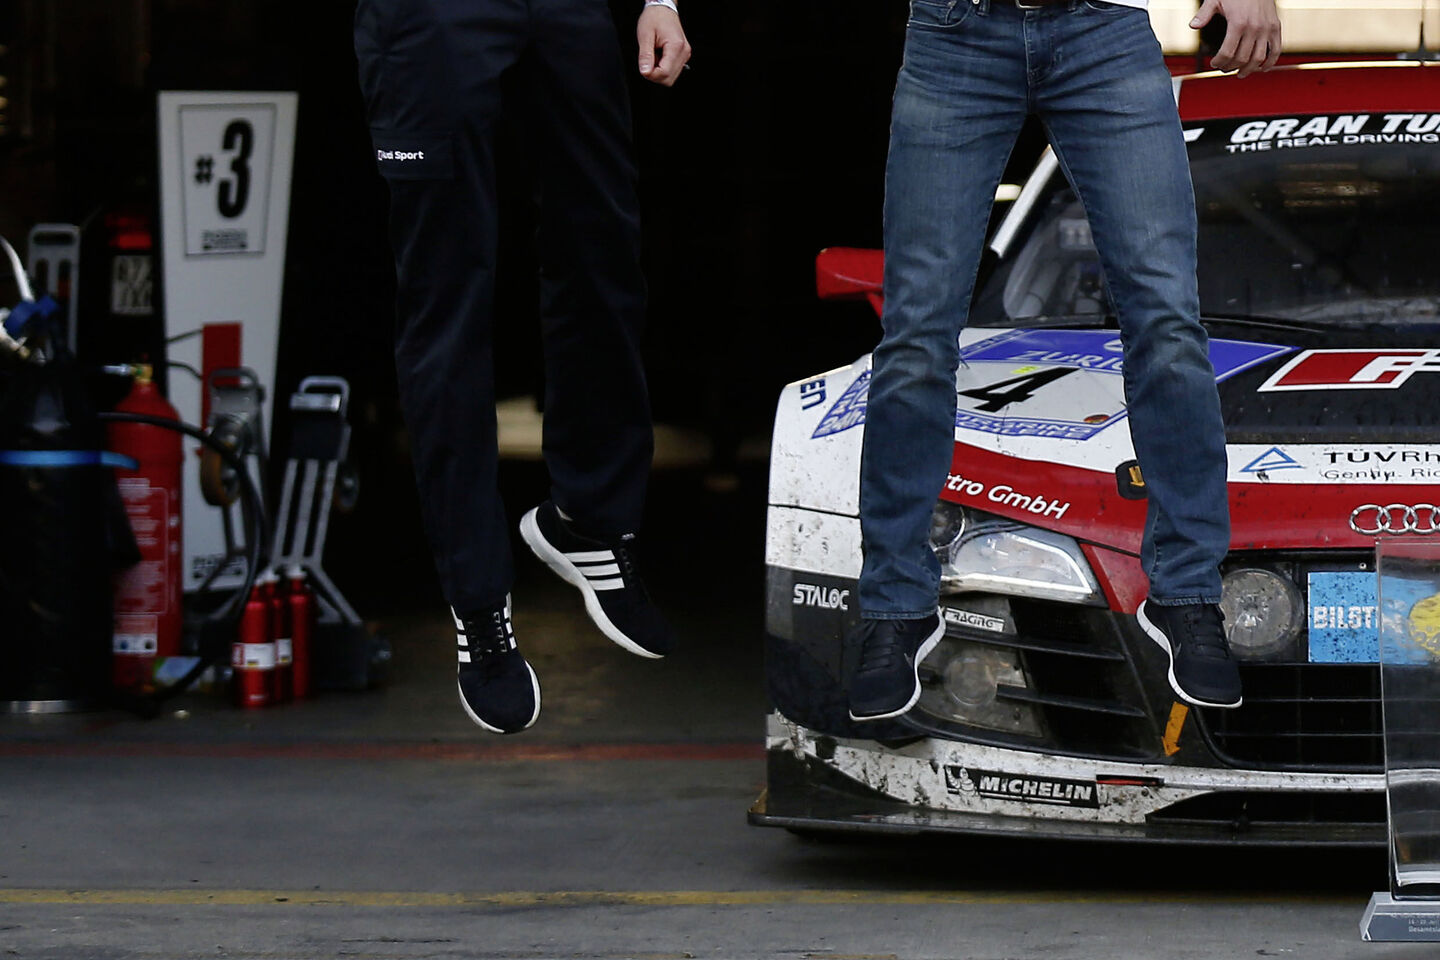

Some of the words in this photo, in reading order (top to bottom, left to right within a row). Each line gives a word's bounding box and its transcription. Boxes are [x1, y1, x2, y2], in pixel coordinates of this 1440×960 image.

[1230, 115, 1370, 143] GRAN
[395, 150, 424, 161] Sport
[1226, 141, 1271, 154] THE
[1277, 137, 1338, 148] REAL
[1343, 133, 1439, 144] DRIVING
[957, 366, 1082, 413] 4
[988, 485, 1070, 520] GmbH
[793, 583, 850, 610] STALOC
[980, 775, 1093, 800] MICHELIN
